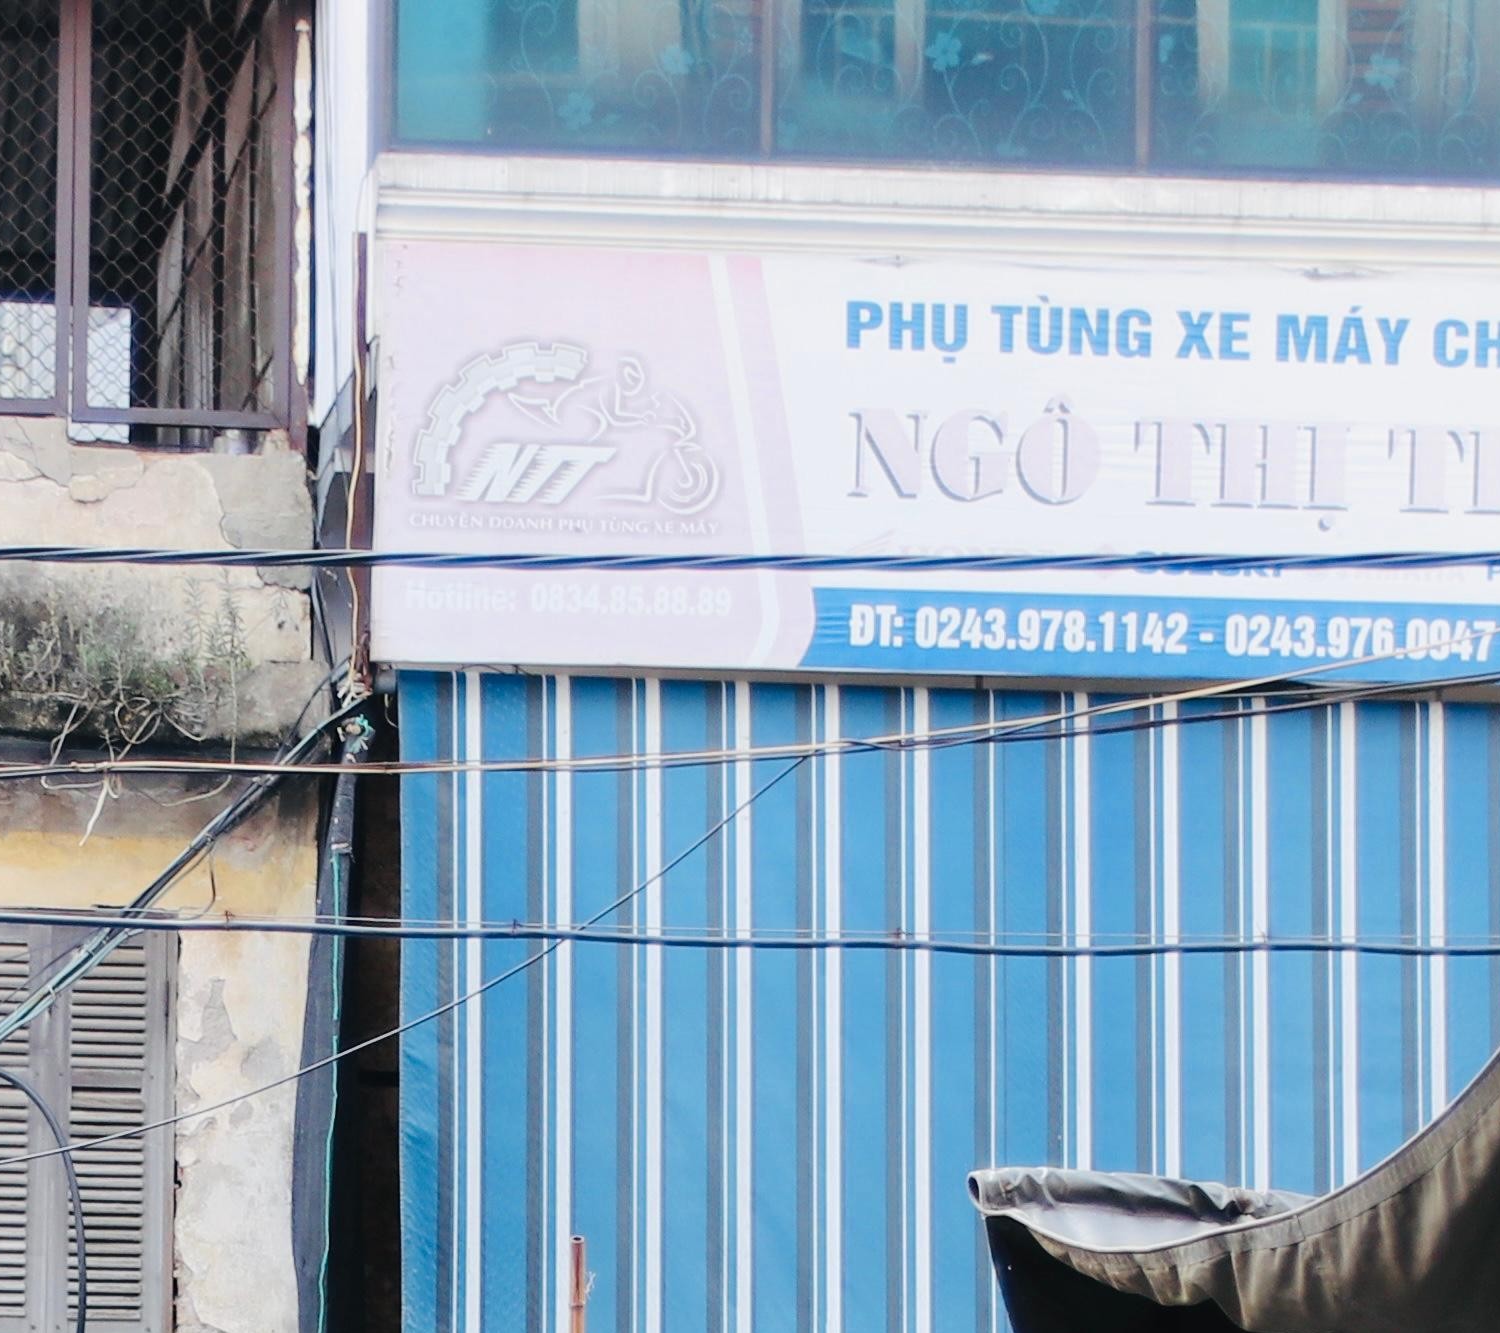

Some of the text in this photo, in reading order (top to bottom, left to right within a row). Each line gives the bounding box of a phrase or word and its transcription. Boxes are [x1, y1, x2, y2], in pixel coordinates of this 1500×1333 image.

[846, 300, 968, 363] PHỤ
[991, 294, 1152, 358] TÙNG
[1175, 310, 1250, 361] XE
[1276, 305, 1410, 365] MÁY
[847, 393, 1101, 505] NGÔ
[1133, 420, 1350, 532] THỊ
[409, 511, 720, 536] CHUYÊN DOANH PHỤ TÙNG XE MÁY
[849, 604, 903, 647] ĐT:
[915, 606, 1188, 655] 0243.978.1142
[1225, 613, 1496, 662] 0243.976.0947
